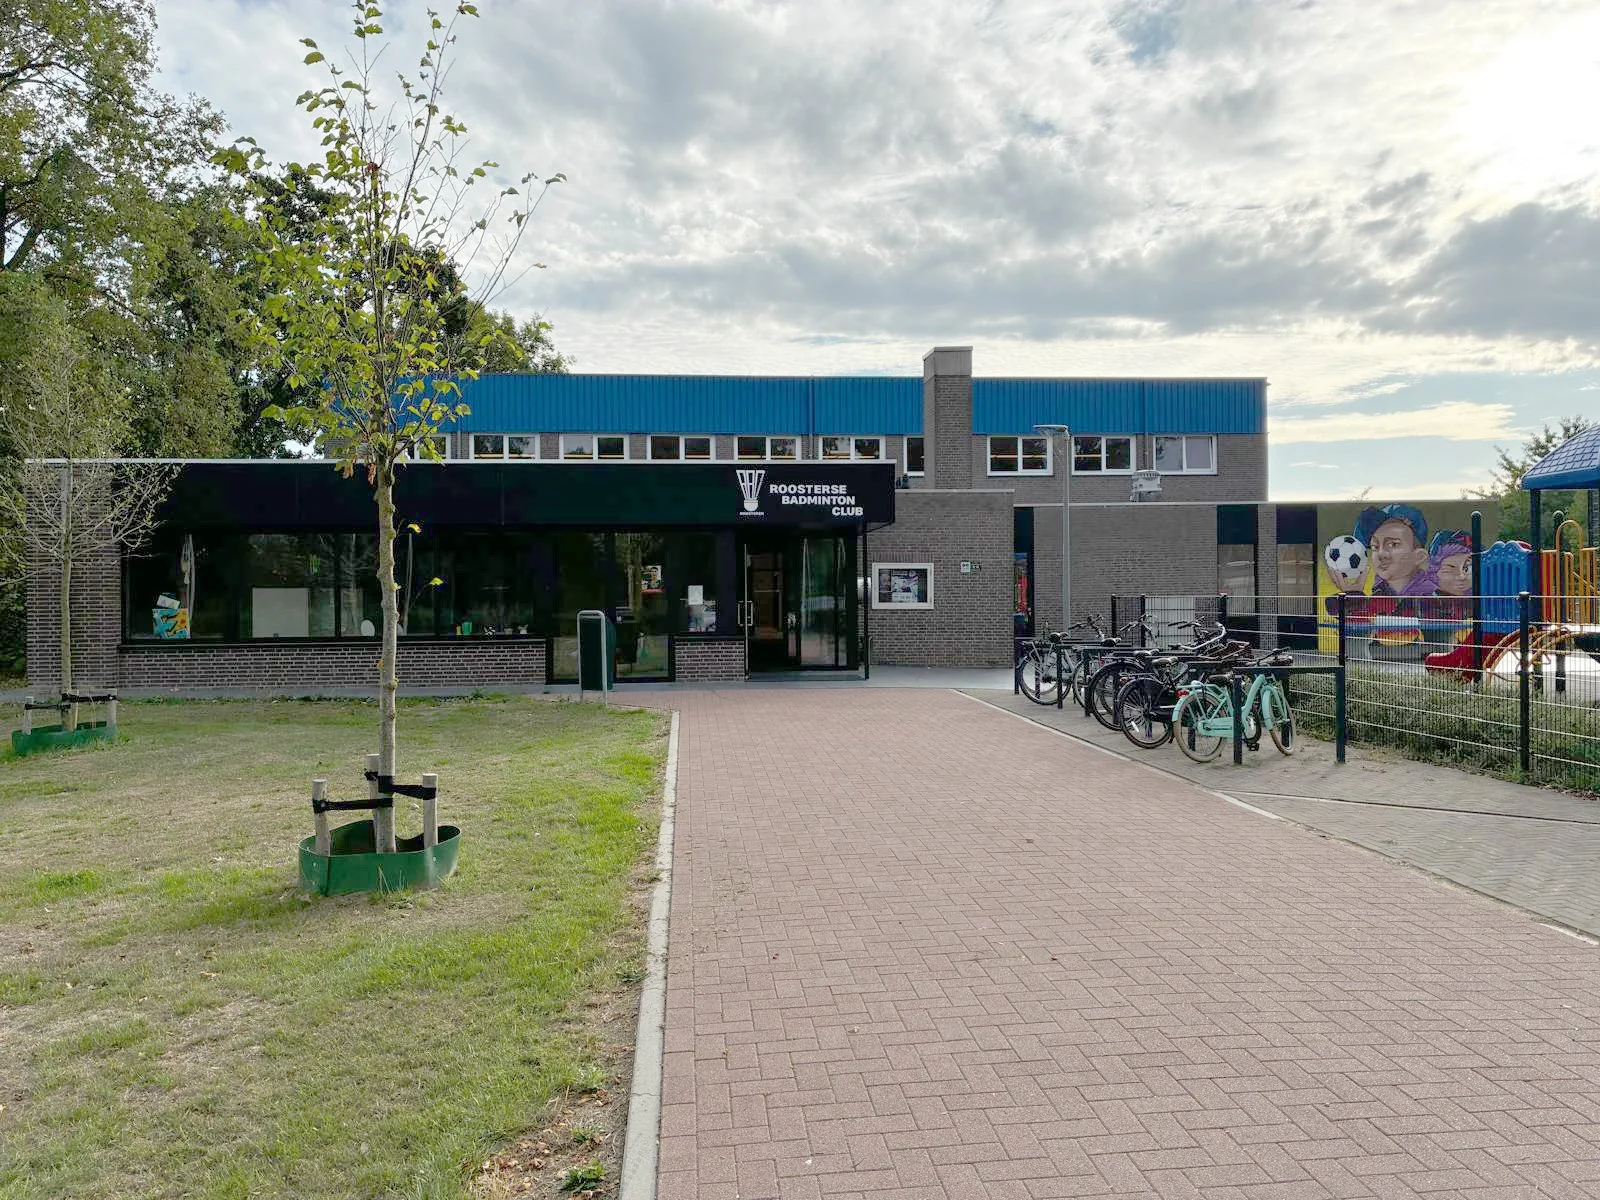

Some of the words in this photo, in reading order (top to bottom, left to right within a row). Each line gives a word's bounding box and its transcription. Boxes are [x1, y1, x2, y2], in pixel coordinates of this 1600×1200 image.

[769, 484, 848, 494] ROOSTERSE
[781, 495, 856, 505] BADMINTON
[831, 506, 864, 516] CLUB
